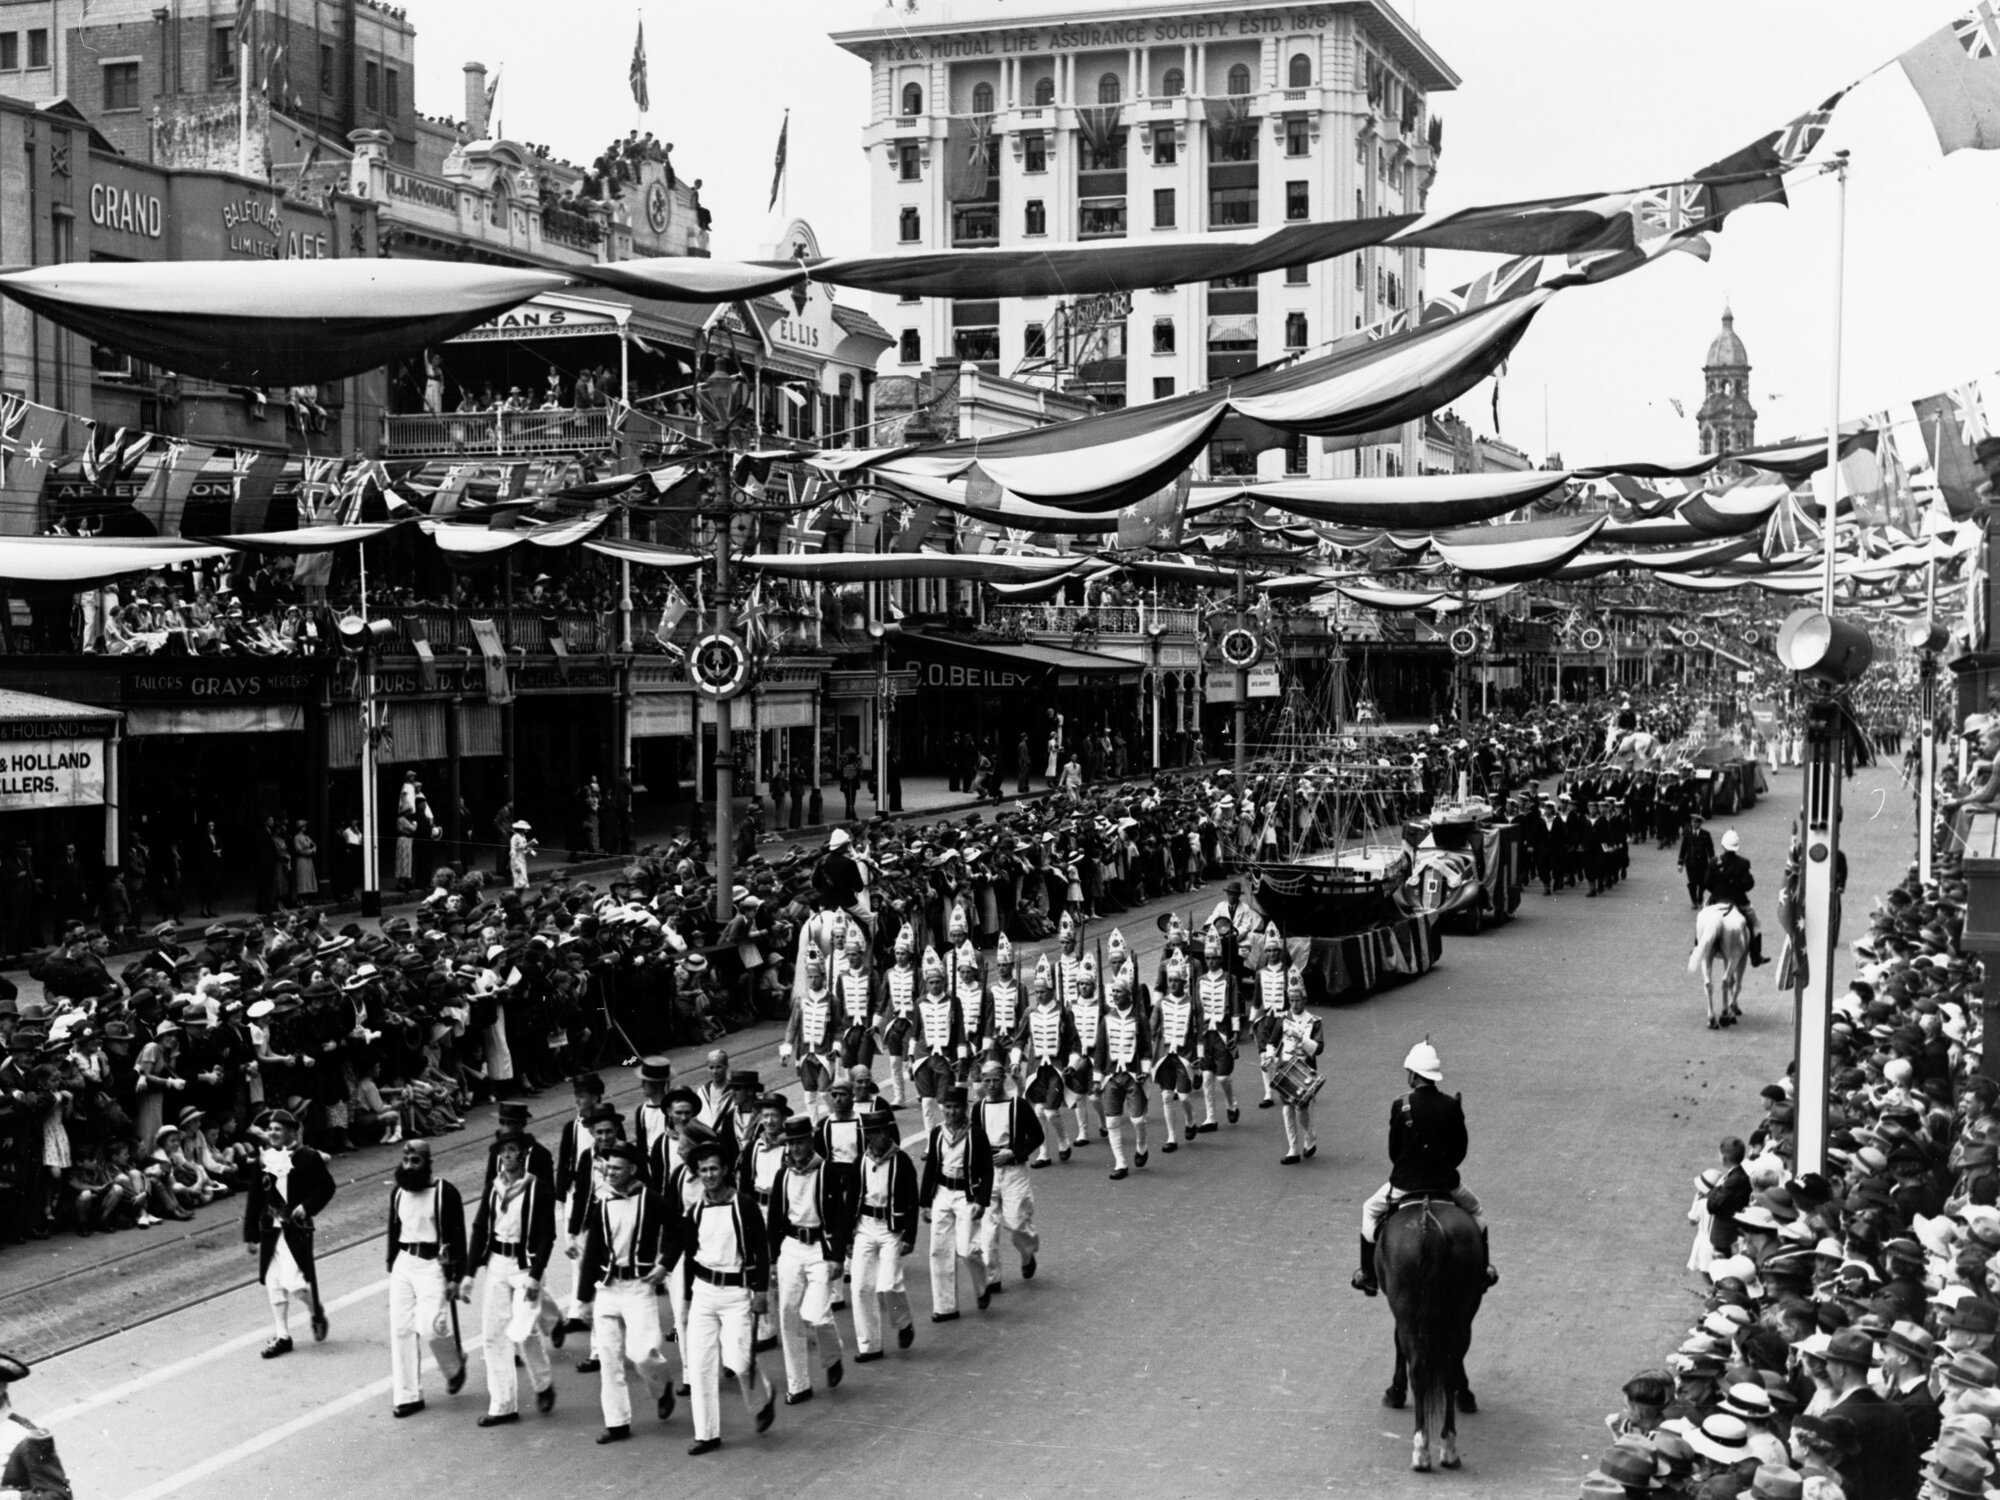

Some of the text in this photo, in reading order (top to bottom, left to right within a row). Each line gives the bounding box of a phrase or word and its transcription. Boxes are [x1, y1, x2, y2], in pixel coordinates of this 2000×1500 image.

[929, 39, 994, 59] MUTUAL
[1002, 35, 1038, 53] LIFE
[1048, 26, 1147, 49] ASSURANCE
[1154, 20, 1229, 41] SOCIETY.
[1238, 16, 1284, 35] ESTD.
[1290, 14, 1328, 31] 1876
[90, 183, 162, 237] GRAND
[282, 231, 326, 259] AFÉ
[779, 319, 819, 347] ELLIS
[134, 674, 184, 690] TAILORS
[191, 676, 262, 696] GRAYS
[332, 674, 416, 694] BAOURS
[12, 722, 80, 739] HOLLAND
[0, 752, 91, 773] & HOLLAND
[0, 776, 59, 795] LLERS.
